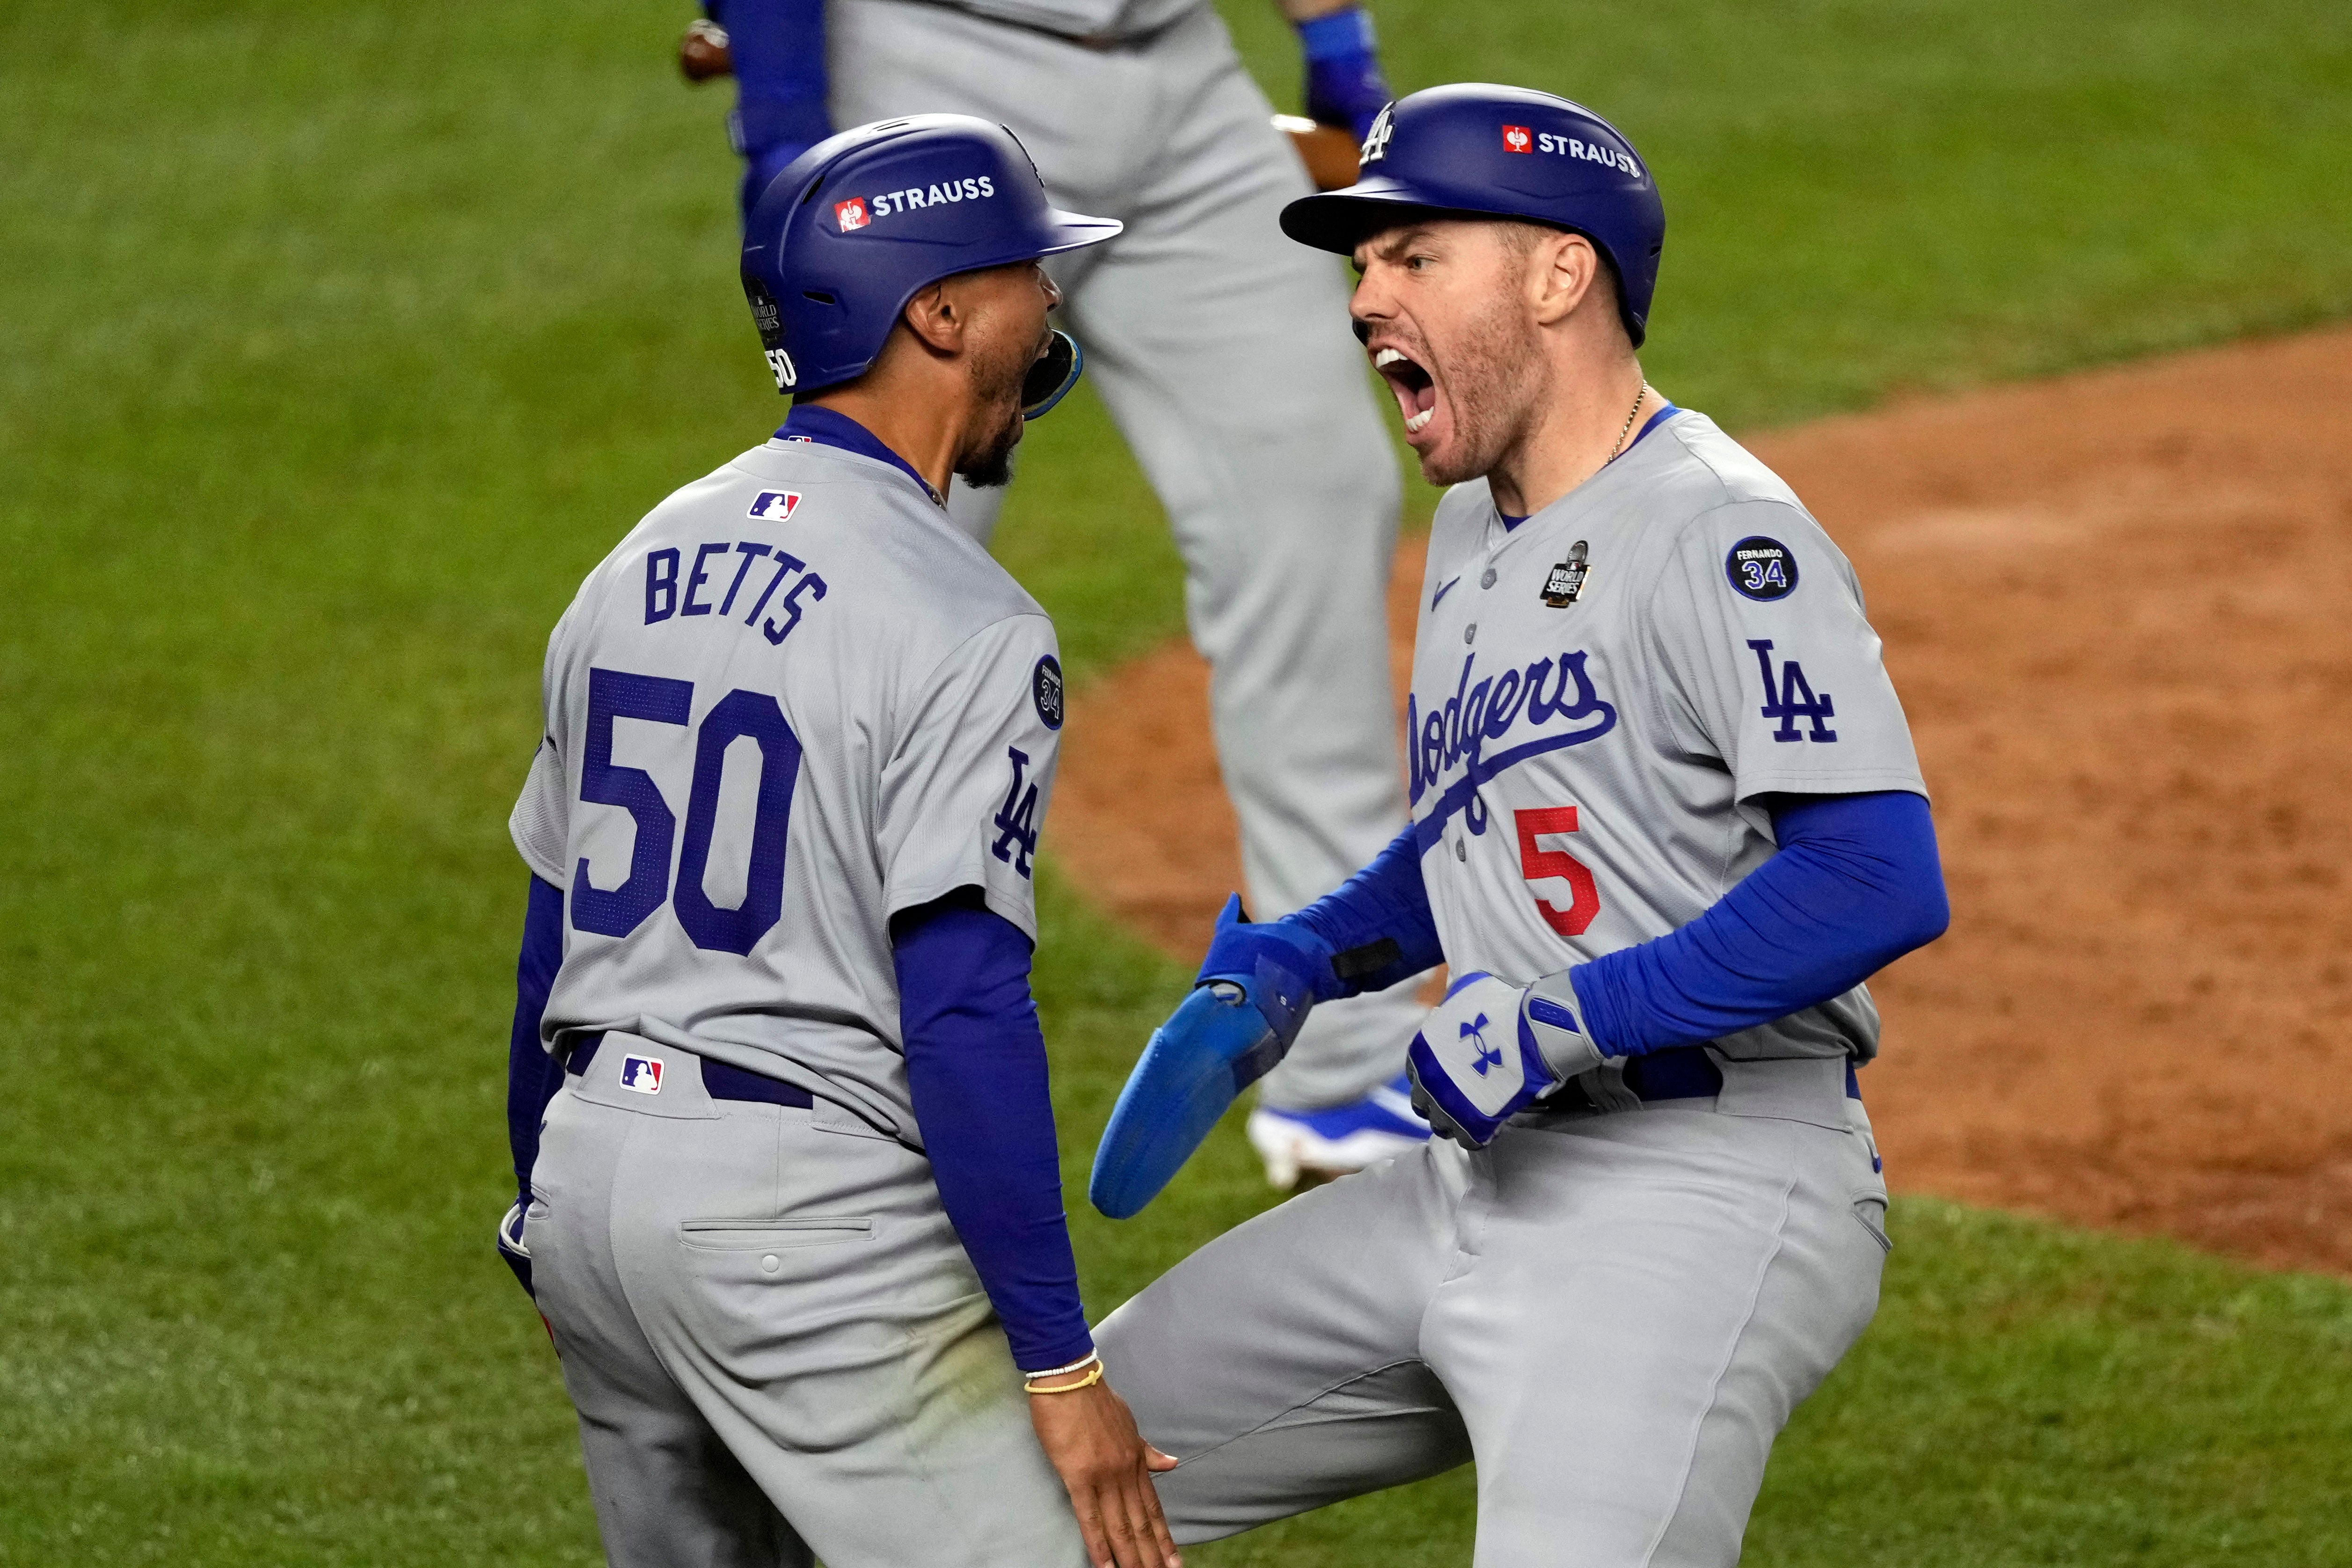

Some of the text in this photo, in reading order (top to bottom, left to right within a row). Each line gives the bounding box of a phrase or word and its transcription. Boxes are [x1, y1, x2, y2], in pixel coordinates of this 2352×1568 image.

[872, 176, 994, 216] STRAUSS
[765, 349, 796, 388] 50
[1737, 549, 1782, 560] FERNANDO
[1742, 560, 1787, 590] 34
[644, 541, 827, 646] BETTS
[1547, 581, 1579, 595] SERIES
[1551, 569, 1584, 582] WORLD
[1040, 678, 1059, 720] 34
[1746, 639, 1837, 743] LA
[570, 667, 803, 957] 50
[992, 745, 1038, 880] LA
[1513, 806, 1601, 936] 5
